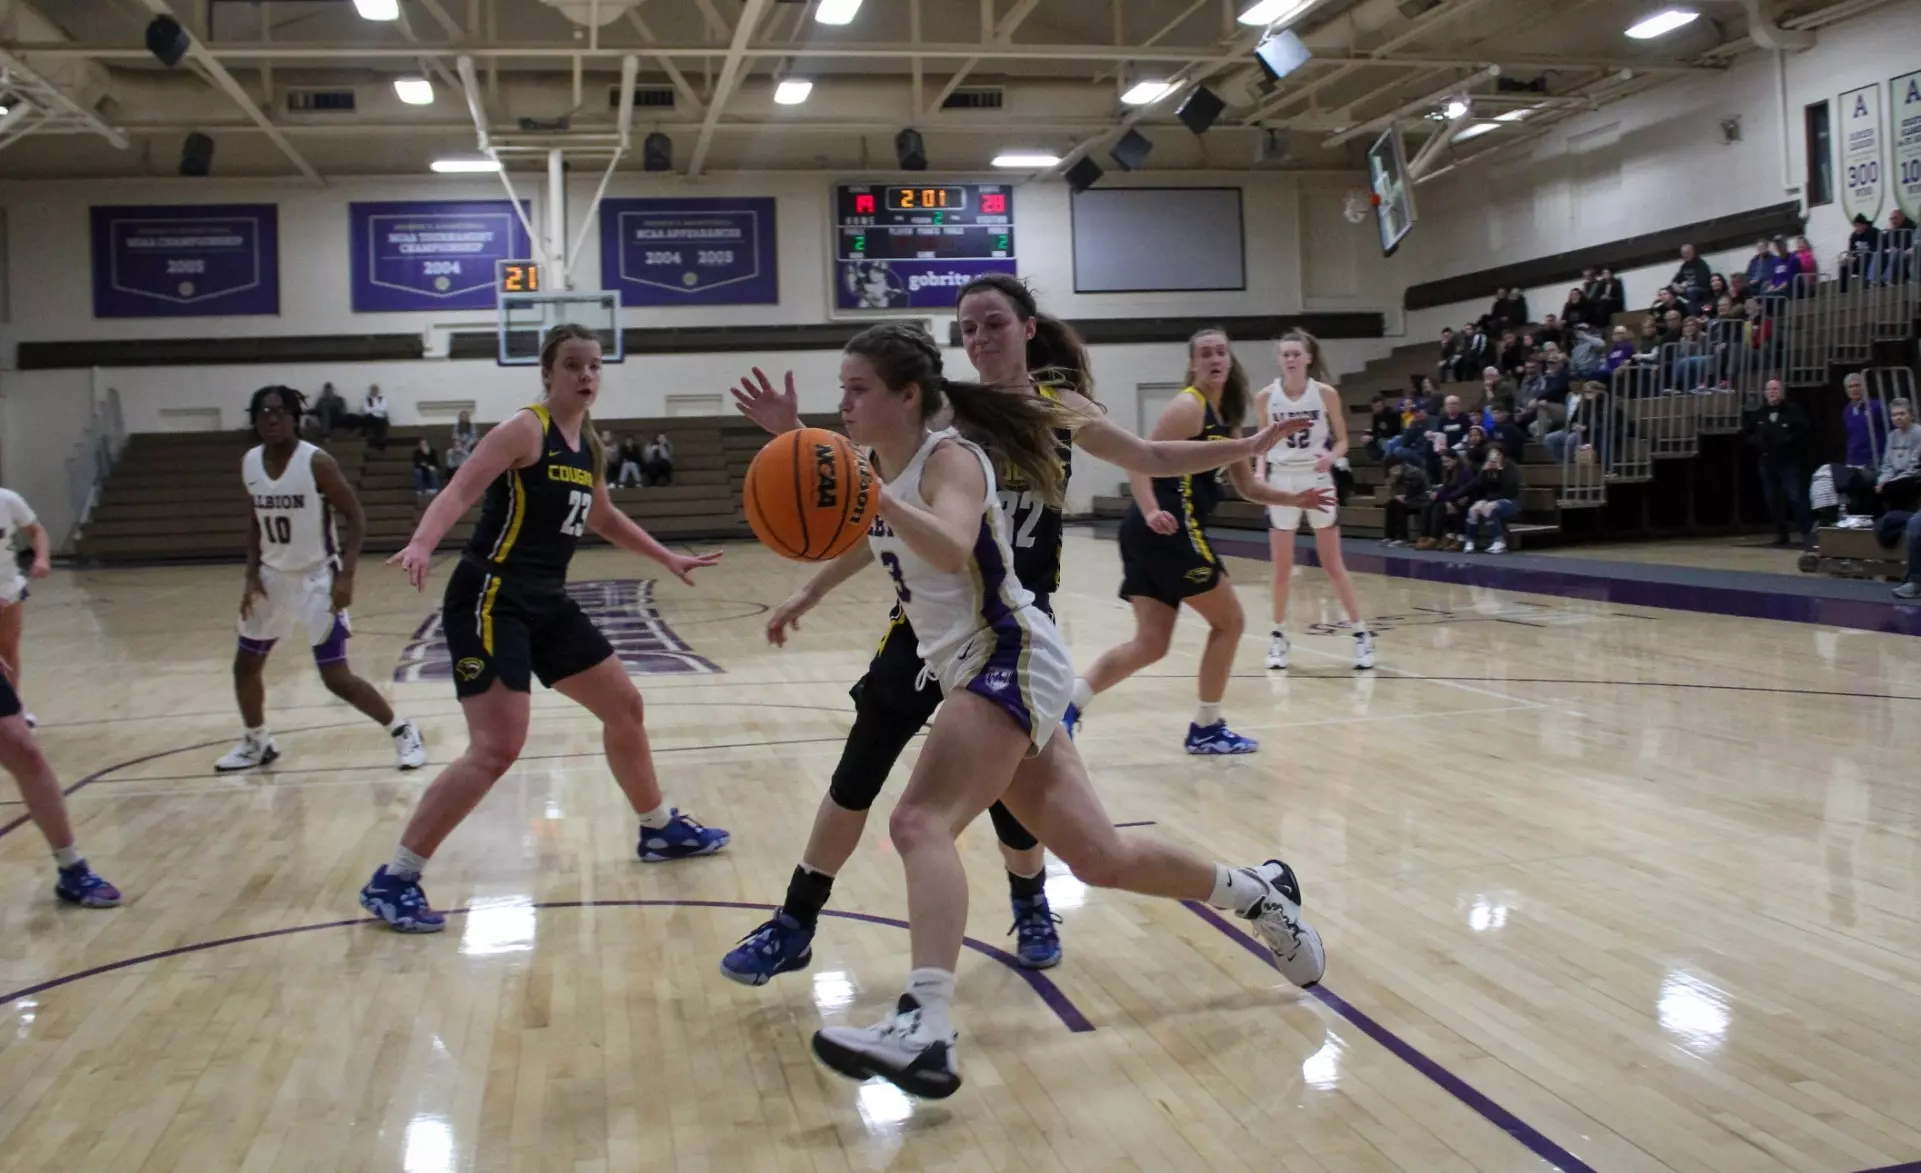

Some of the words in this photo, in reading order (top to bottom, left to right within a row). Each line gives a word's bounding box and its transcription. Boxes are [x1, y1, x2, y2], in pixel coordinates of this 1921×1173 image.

[1904, 78, 1921, 105] A
[1853, 93, 1868, 119] A
[1848, 160, 1878, 188] 300
[505, 265, 538, 291] 21
[816, 443, 837, 508] NCAA
[255, 494, 305, 509] LBION
[264, 516, 291, 544] 10
